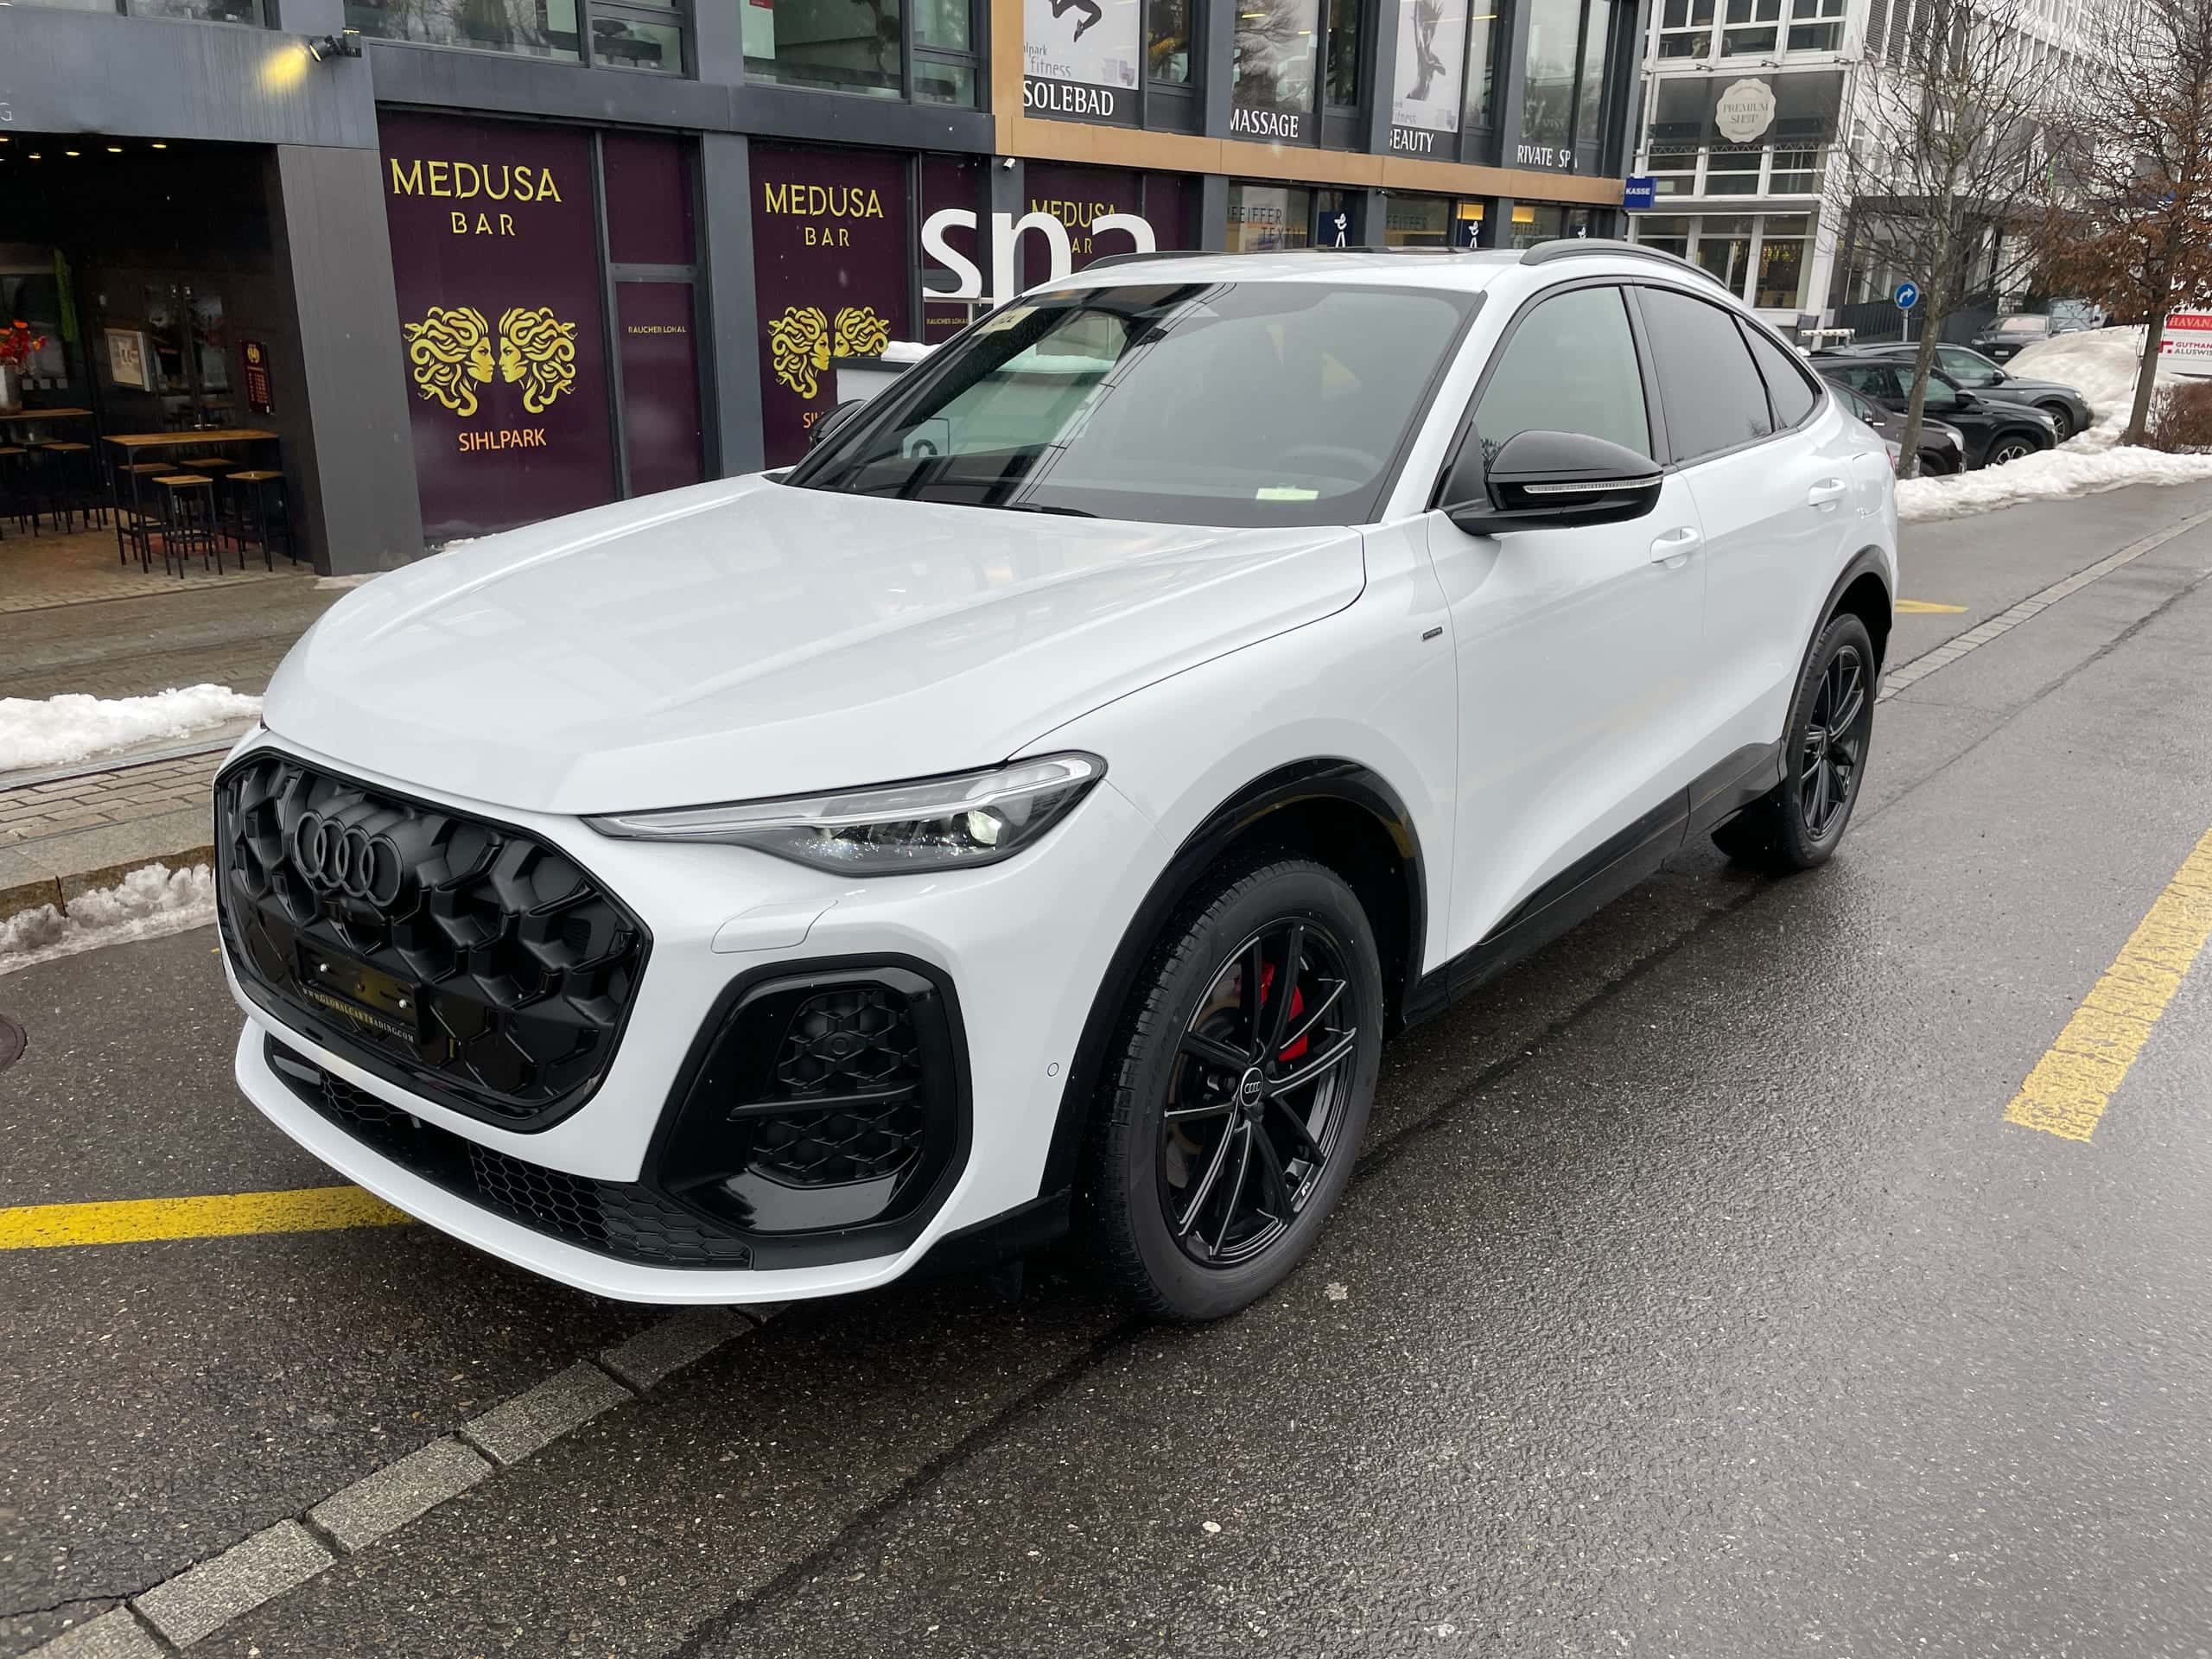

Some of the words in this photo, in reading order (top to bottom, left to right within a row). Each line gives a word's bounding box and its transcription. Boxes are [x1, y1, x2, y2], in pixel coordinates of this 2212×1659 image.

[1030, 55, 1072, 77] fitness
[1023, 80, 1114, 116] SOLEBAD
[1230, 108, 1300, 138] MASSAGE
[1516, 144, 1553, 167] RIVATE
[1558, 149, 1578, 169] SP
[390, 158, 563, 202] MEDUSA
[765, 182, 884, 218] MEDUSA
[1625, 188, 1651, 196] KASSE
[451, 212, 516, 236] BAR
[804, 227, 851, 248] BAR
[1071, 238, 1092, 254] AR
[2170, 317, 2212, 328] HAVAN
[458, 429, 547, 452] SIHLPARK
